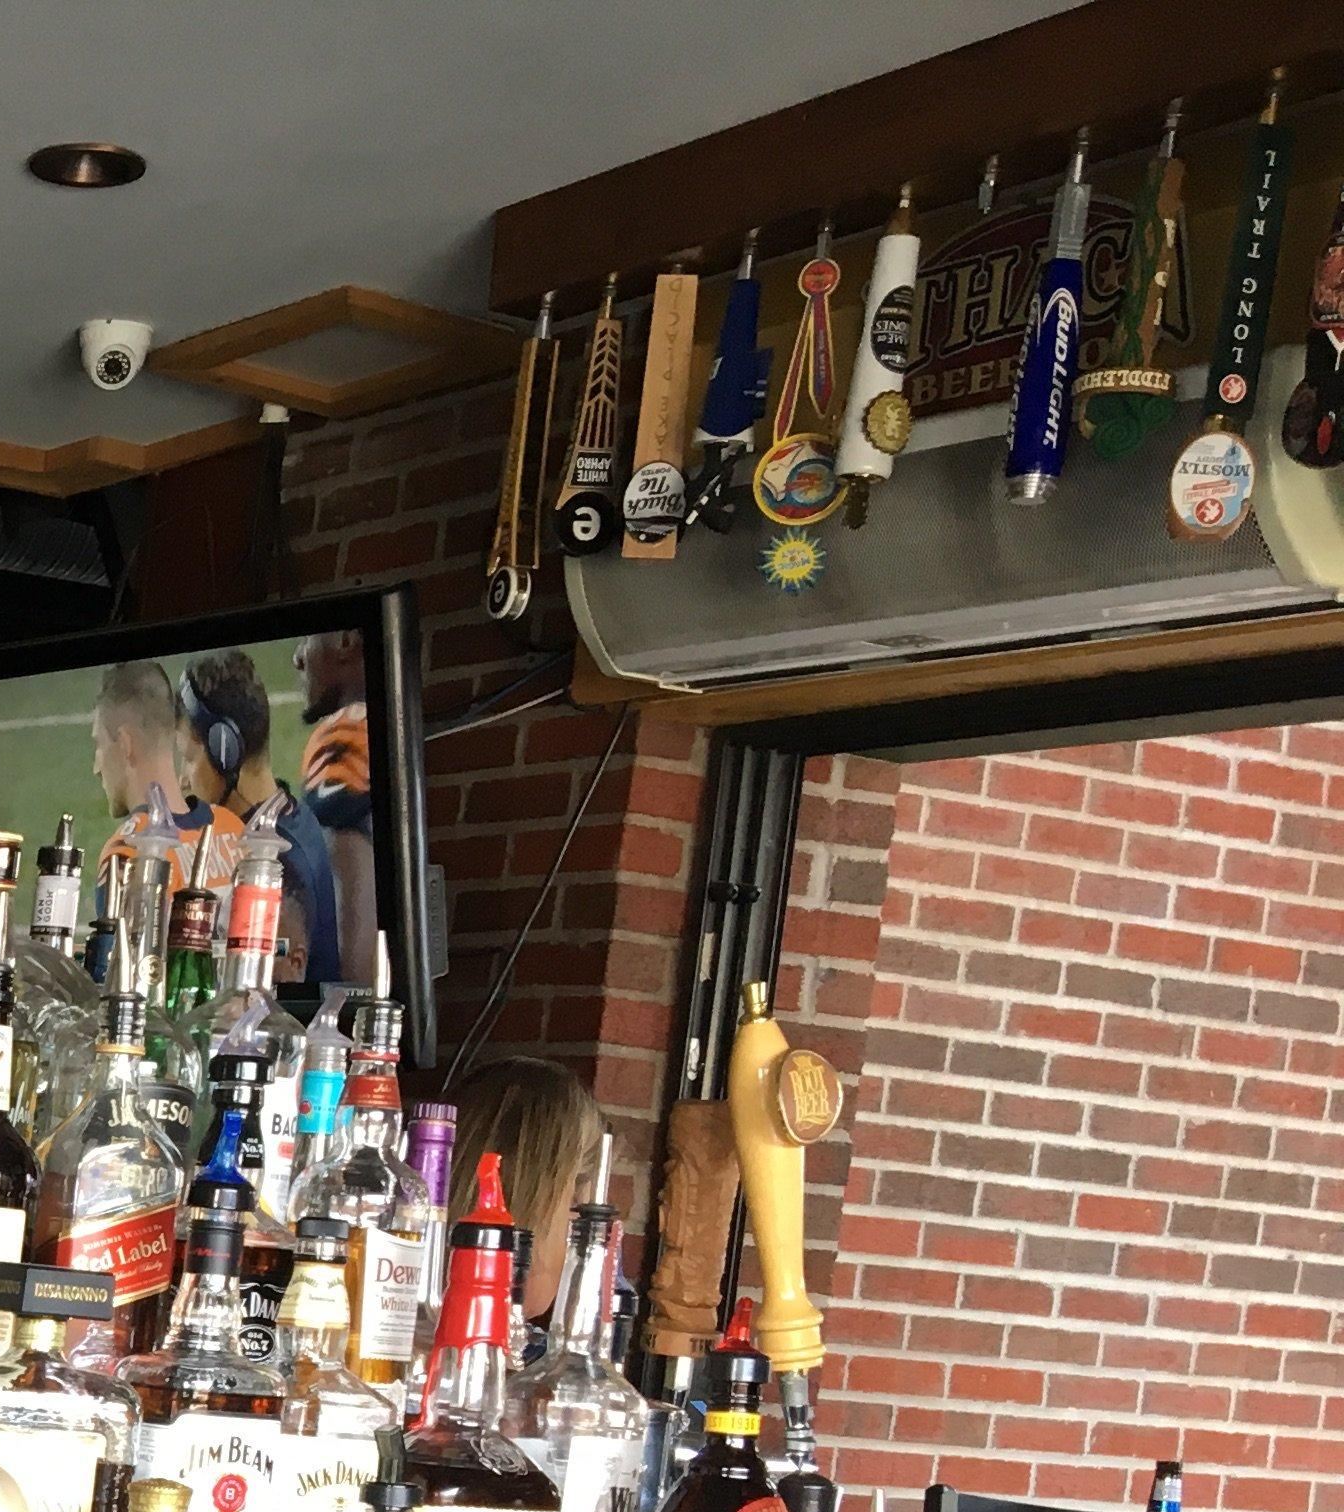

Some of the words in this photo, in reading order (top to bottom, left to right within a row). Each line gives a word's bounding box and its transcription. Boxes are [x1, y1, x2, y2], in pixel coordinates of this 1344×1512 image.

[1232, 277, 1259, 364] LONG
[1247, 149, 1277, 260] TRAIL
[1054, 299, 1074, 362] BUD
[576, 455, 612, 470] APHRO
[1178, 460, 1250, 478] MOSTLY
[576, 469, 610, 484] WHITE
[637, 475, 675, 496] Tie
[626, 491, 687, 518] Black
[35, 899, 45, 923] VAN
[43, 890, 54, 923] GOGH
[120, 1232, 169, 1265] Label
[33, 1282, 109, 1304] DISARONNO
[178, 1443, 224, 1480] JIM
[227, 1435, 275, 1485] BEAM
[296, 1469, 332, 1498] JACK
